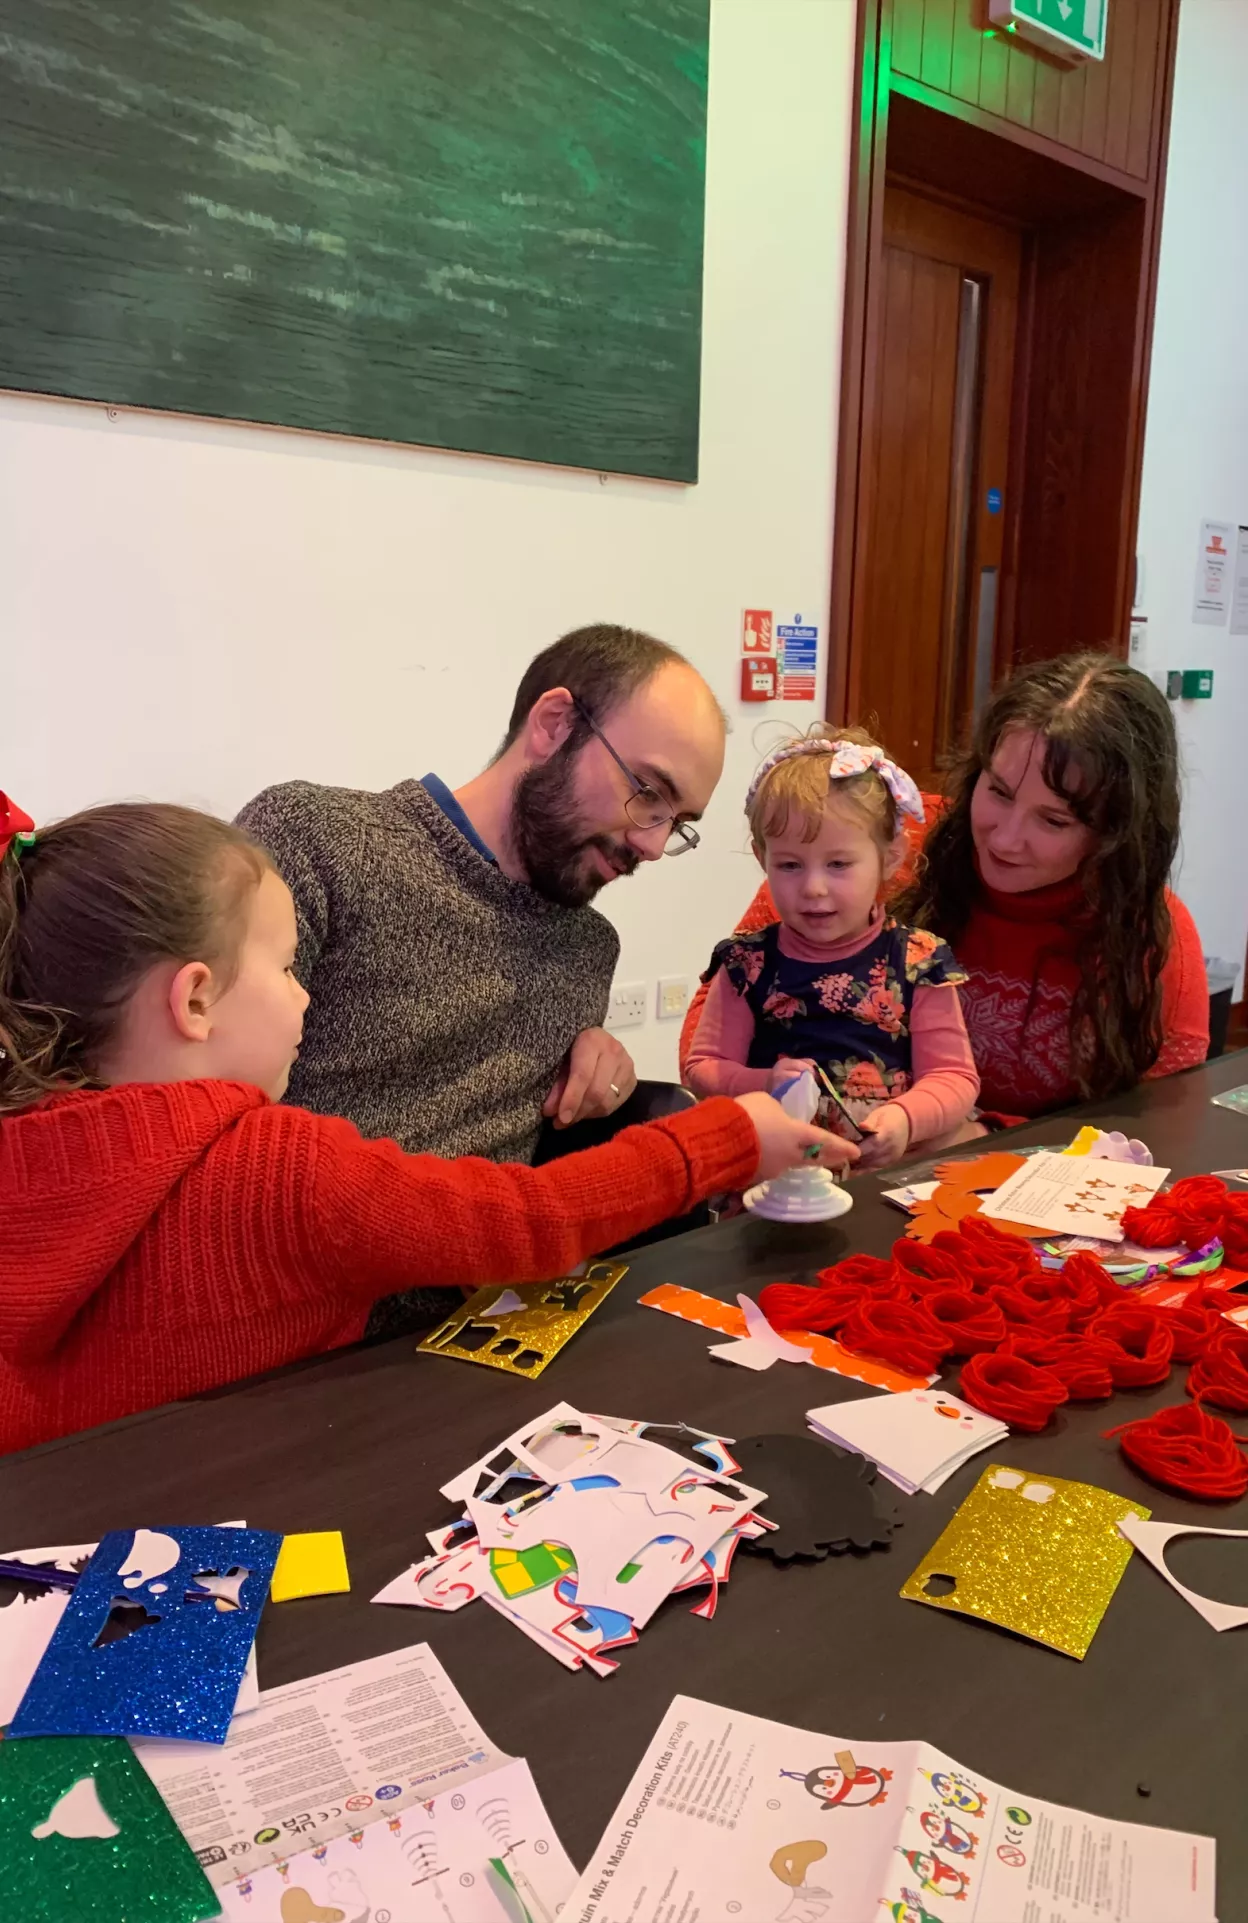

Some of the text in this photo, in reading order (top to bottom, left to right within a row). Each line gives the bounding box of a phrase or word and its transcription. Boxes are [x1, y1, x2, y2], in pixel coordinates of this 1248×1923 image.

[780, 627, 815, 637] Fire Action
[667, 1720, 689, 1751] (AT240)
[439, 1762, 469, 1777] Baker
[655, 1750, 673, 1772] Kits
[626, 1771, 662, 1829] Decoration
[607, 1830, 634, 1867] Match
[602, 1867, 615, 1878] &
[590, 1879, 610, 1902] Mix
